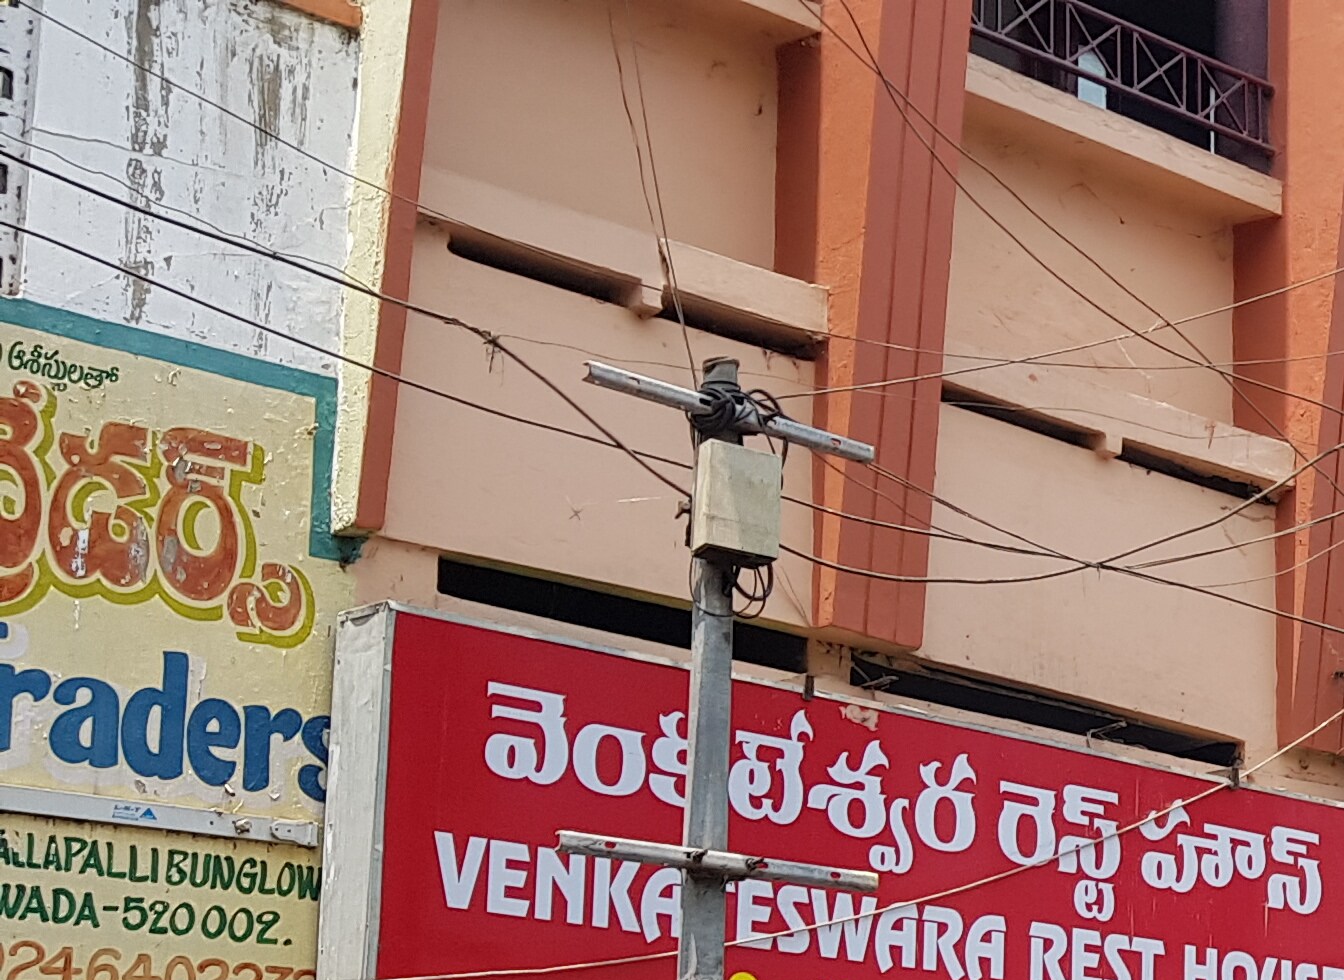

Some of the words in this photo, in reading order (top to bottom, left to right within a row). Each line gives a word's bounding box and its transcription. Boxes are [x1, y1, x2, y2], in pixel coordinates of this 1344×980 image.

[0, 640, 331, 802] raders
[165, 848, 322, 901] BUNGLOW
[998, 780, 1122, 922] రెస్ట్
[1140, 798, 1323, 915] హౌస్
